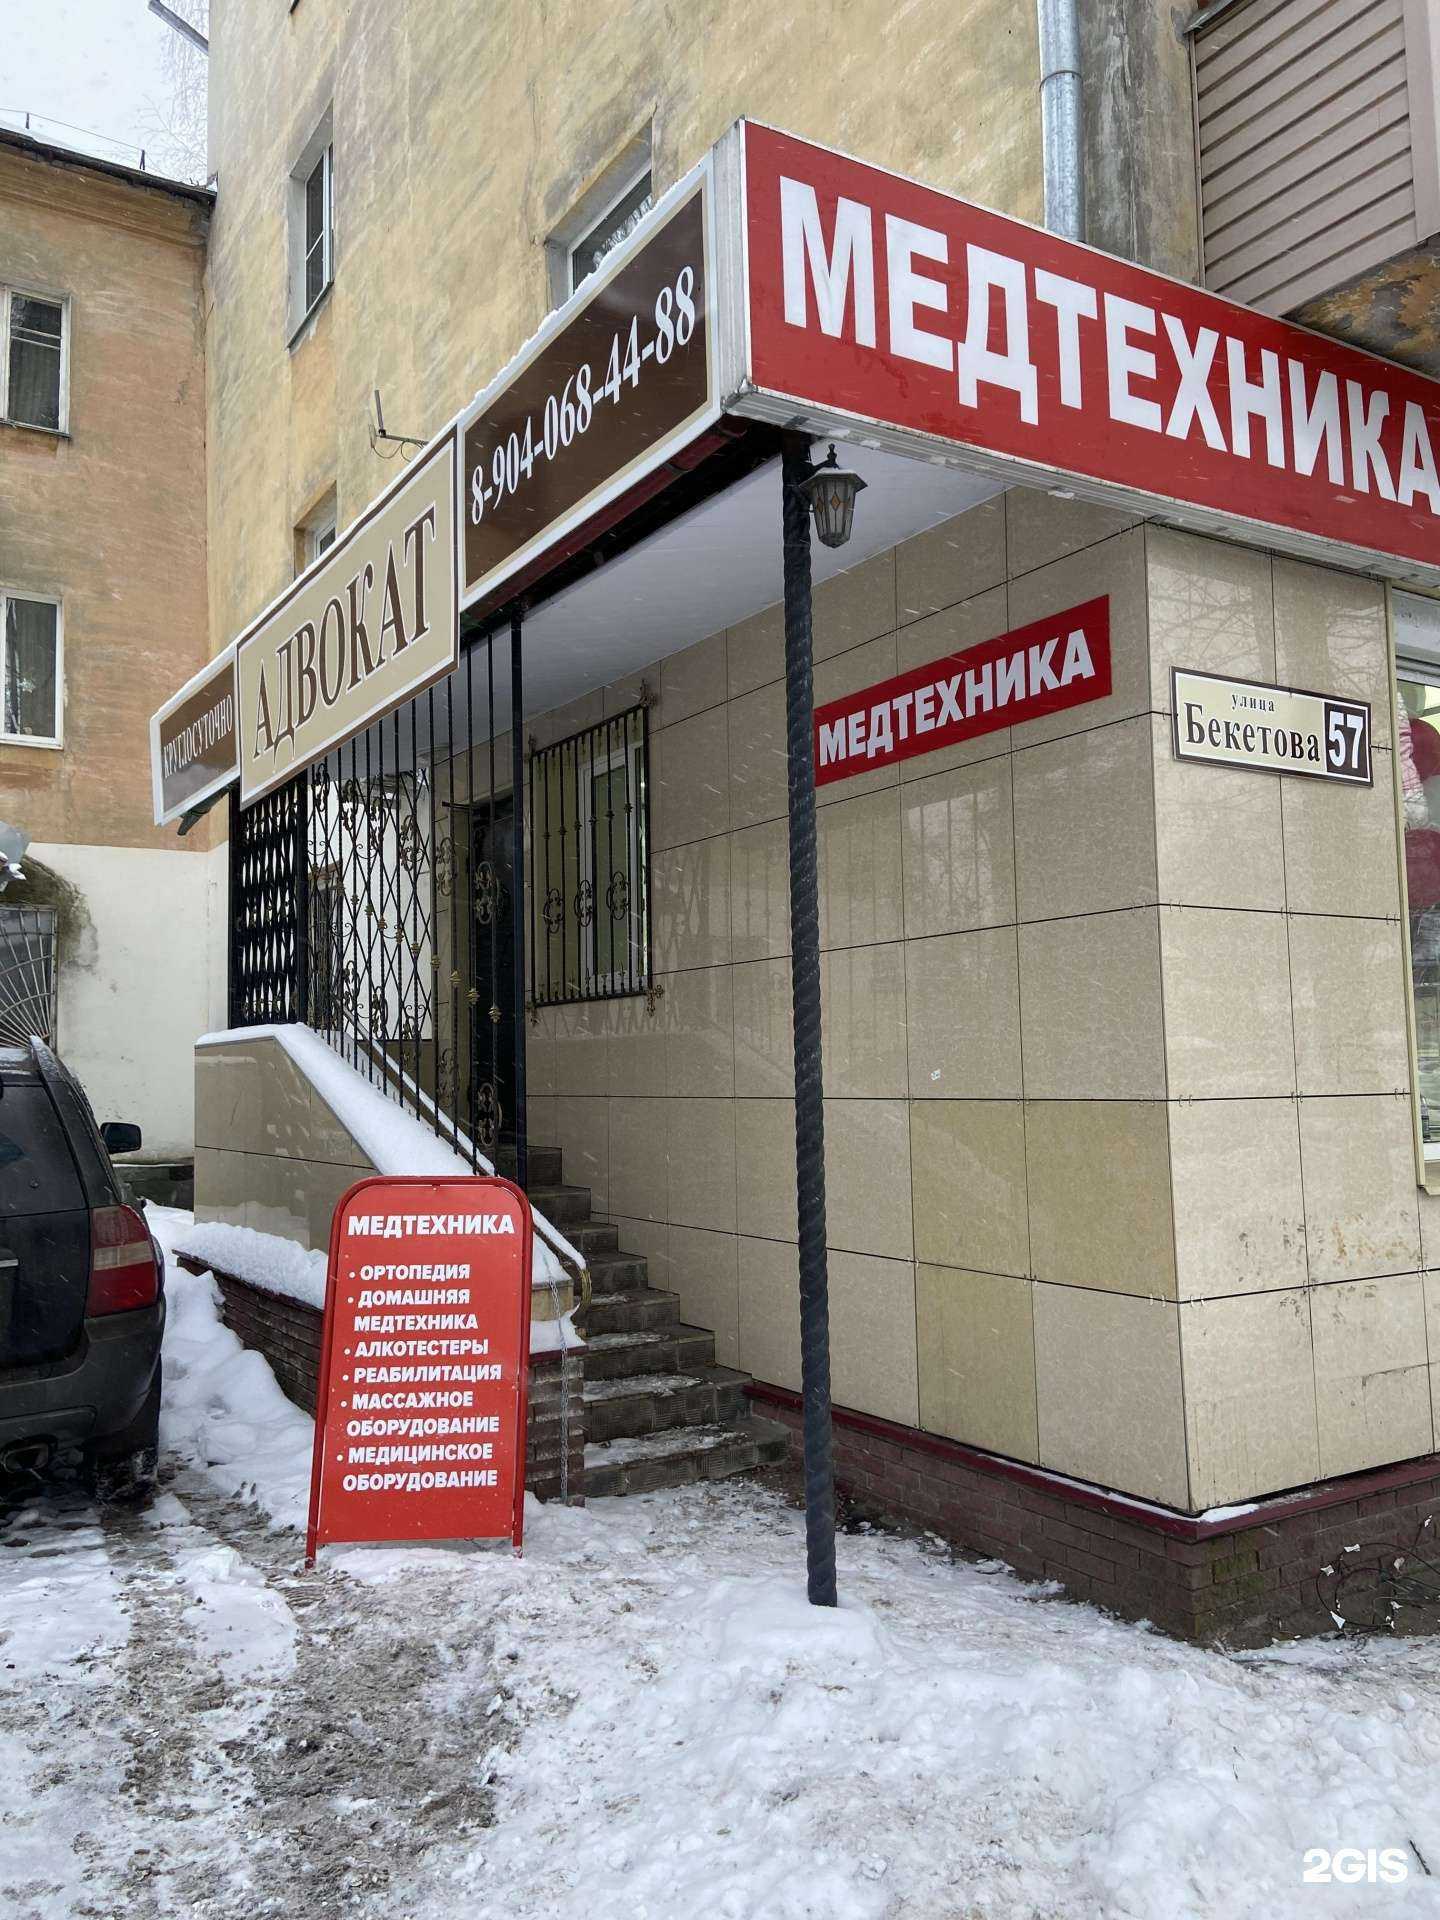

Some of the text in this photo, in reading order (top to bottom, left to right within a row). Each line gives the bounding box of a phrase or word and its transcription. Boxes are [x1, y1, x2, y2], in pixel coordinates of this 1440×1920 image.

[780, 175, 1440, 516] МЕДТЕХНИКА
[470, 265, 696, 526] 8-904-068-44-88
[252, 502, 437, 766] АДВОКАТ
[818, 628, 1096, 767] МЕДТЕХНИКА
[1231, 692, 1275, 712] улица
[163, 694, 233, 779] КРУГЛОСУТОЧНО
[1183, 702, 1321, 762] Бекетова
[1328, 710, 1364, 769] 57
[347, 1214, 515, 1239] МЕДТЕХНИКА
[360, 1264, 471, 1282] ОРТОПЕДИЯ
[358, 1289, 471, 1308] ДОМАШНЯЯ
[353, 1314, 479, 1333] МЕДТЕХНИКА
[354, 1339, 489, 1357] АЛКОТЕСТЕРЫ
[353, 1364, 502, 1383] РЕАБИЛИТАЦИЯ
[352, 1391, 474, 1410] МАССАЖНОЕ
[346, 1416, 500, 1437] ОБОРУДОВАНИЕ
[348, 1443, 493, 1465] МЕДИЦИНСКОЕ
[342, 1470, 498, 1491] ОБОРУДОВАНИЕ
